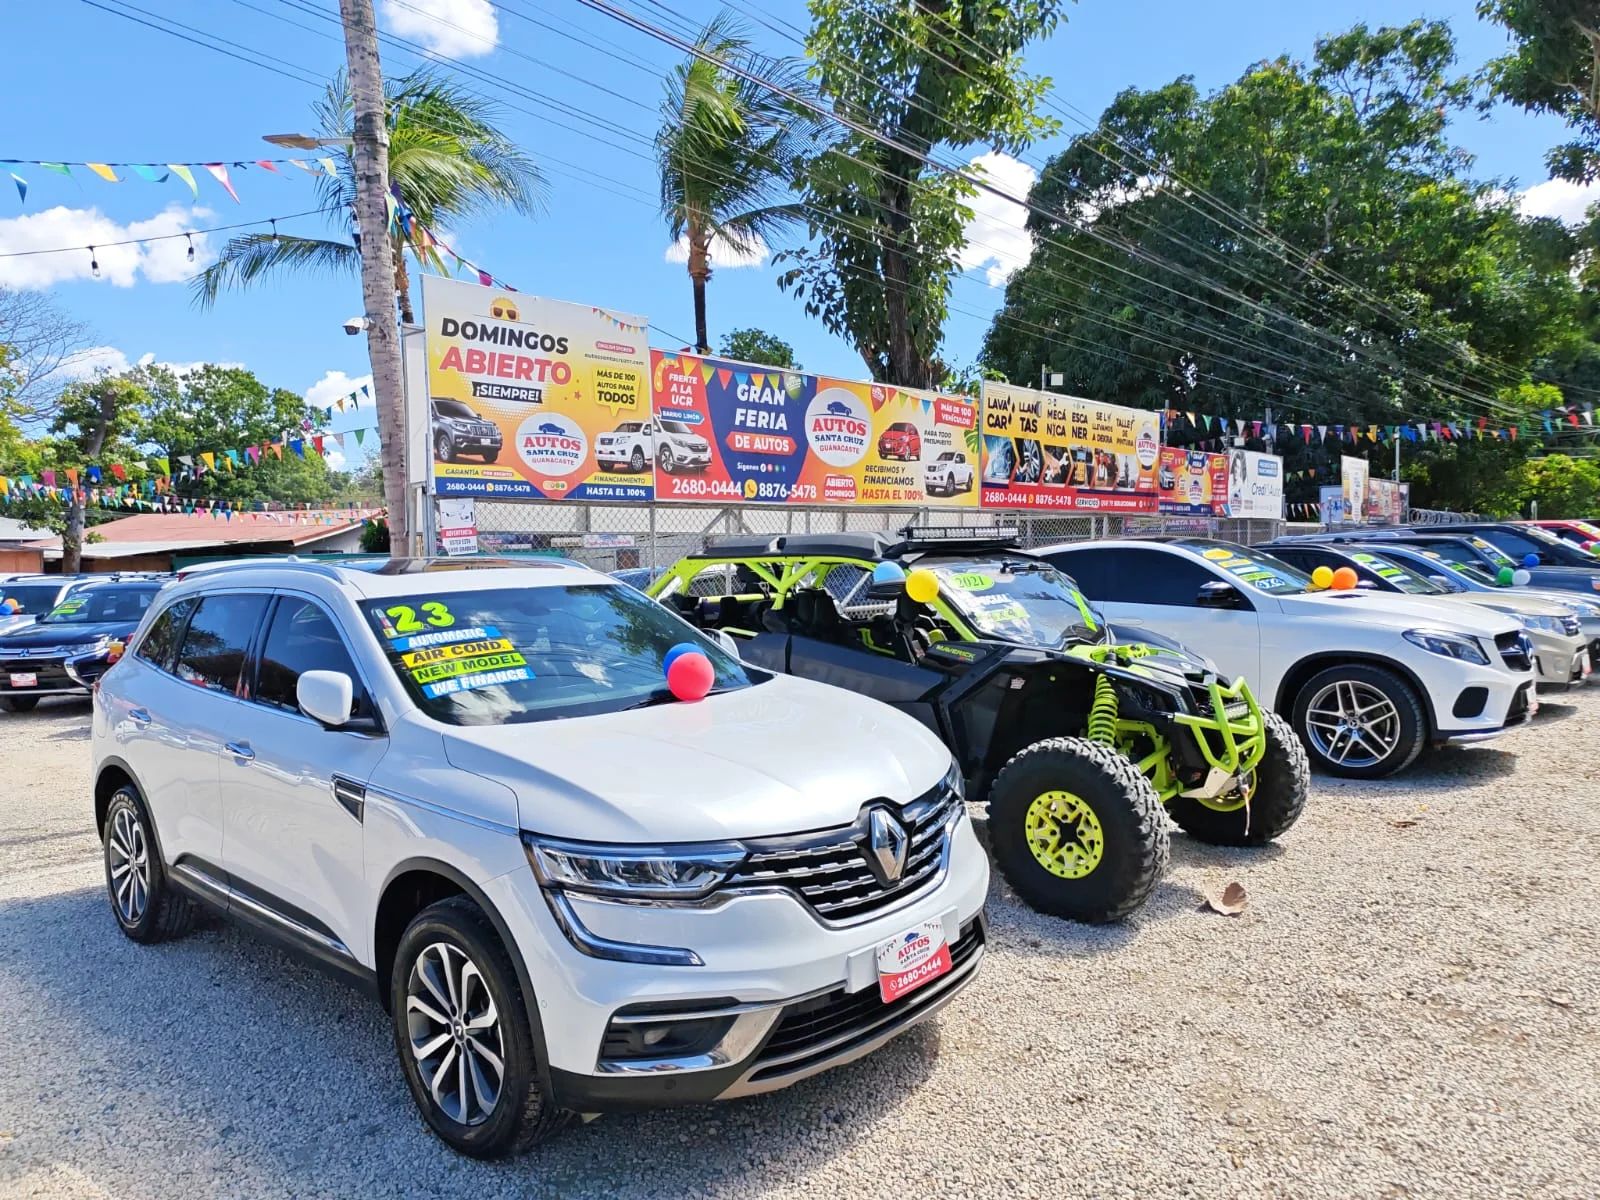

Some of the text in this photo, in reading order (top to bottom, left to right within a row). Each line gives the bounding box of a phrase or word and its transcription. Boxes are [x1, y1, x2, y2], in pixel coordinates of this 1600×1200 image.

[442, 318, 568, 354] DOMINGOS
[440, 346, 572, 385] ABIERTO
[614, 372, 624, 380] DE
[624, 374, 636, 382] 100
[669, 373, 698, 384] FRENTE
[476, 384, 540, 400] ¡SIEMPRE!
[597, 382, 617, 390] AUTOS
[670, 384, 692, 395] A LA
[598, 390, 636, 404] TODOS
[672, 395, 694, 406] UCR
[737, 384, 786, 406] GRAN
[988, 396, 1008, 410] LAVA
[961, 406, 972, 416] 100
[1047, 408, 1066, 420] MECÁ
[1072, 412, 1088, 424] ESCA
[735, 408, 788, 430] FERIA
[987, 414, 1008, 430] CAR
[1020, 417, 1038, 433] TAS
[812, 418, 866, 436] AUTOS
[924, 430, 938, 438] PARA
[1072, 426, 1088, 440] NER
[524, 436, 581, 452] AUTOS
[735, 434, 790, 452] DE AUTOS
[844, 436, 864, 446] CRUZ
[557, 450, 580, 459] CRUZ
[820, 444, 860, 454] GUANACASTE
[865, 464, 900, 474] RECIBIMOS
[594, 476, 646, 484] FINANCIAMIENTO
[864, 475, 914, 486] FINANCIAMOS
[494, 484, 530, 492] 8876-5478
[586, 487, 646, 497] HASTA EL 100%
[672, 479, 816, 498] 2680-0444 8876-5478
[862, 488, 924, 500] HASTA EL 100%
[985, 492, 1072, 504] 2680-0444 8876-5478
[956, 576, 984, 588] 2021
[386, 602, 455, 632] 23
[408, 627, 487, 648] AUTOMATIC
[412, 648, 445, 664] AIR
[417, 654, 521, 680] NEW MODEL
[431, 668, 528, 694] WE FINANCE
[898, 936, 930, 958] AUTOS
[898, 957, 942, 988] 2680-0444
